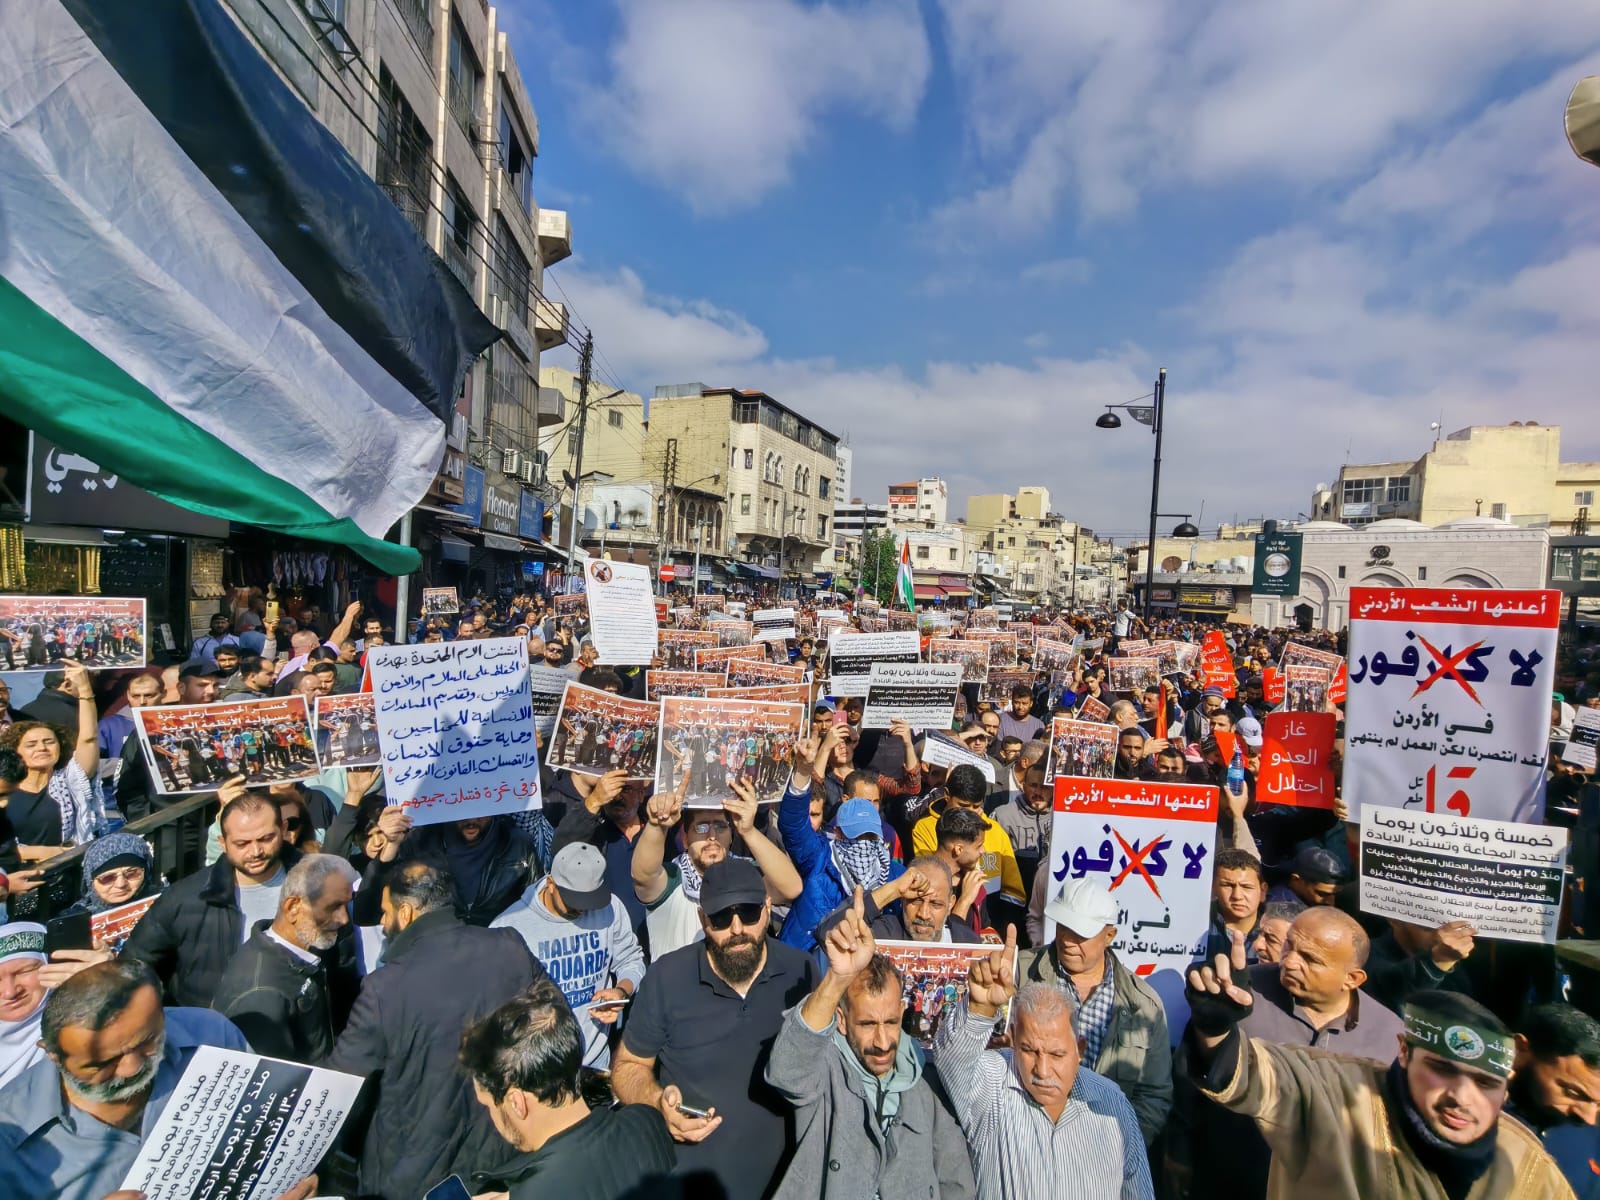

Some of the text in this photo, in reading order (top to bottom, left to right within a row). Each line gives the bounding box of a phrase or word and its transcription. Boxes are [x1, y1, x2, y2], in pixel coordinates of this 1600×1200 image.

[1359, 592, 1547, 617] أعلنها الشعب الأردني
[411, 647, 455, 664] المتحدة
[1350, 630, 1495, 690] كارفور
[469, 667, 489, 681] على
[1509, 649, 1543, 687] لا
[422, 669, 465, 692] السلام
[157, 701, 289, 722] كسر الحصار على غزة
[679, 701, 695, 712] غزة
[761, 708, 792, 716] كسر
[161, 713, 292, 732] مسؤولية الأنظمة العربية
[471, 706, 532, 725] الانسانية
[678, 715, 712, 727] العربية
[715, 715, 751, 726] الأنظمة
[1393, 703, 1494, 742] في الأردن
[495, 729, 532, 746] وحماية
[1280, 720, 1307, 740] غاز
[448, 734, 492, 754] حقوق
[1350, 735, 1384, 749] ينتهي
[1385, 735, 1399, 748] لم
[1401, 738, 1437, 753] العمل
[1439, 744, 1465, 756] لكن
[478, 753, 536, 773] والتمسك
[1271, 748, 1317, 767] العدو
[1468, 746, 1517, 763] انتصرنا
[434, 760, 479, 779] بالقانون
[484, 780, 511, 802] غزة
[512, 779, 538, 797] وفي
[1267, 772, 1323, 794] احتلال
[1064, 783, 1211, 811] أعلنها الشعب الأردني
[1421, 820, 1489, 842] وثلاثون
[1494, 828, 1553, 847] خمسة
[1053, 824, 1208, 882] لا كارفور
[1366, 847, 1396, 858] عمليات
[1409, 838, 1460, 854] وتستمر
[1463, 843, 1516, 860] المجاعة
[1396, 853, 1437, 865] الصهيوني
[1438, 860, 1469, 870] الاحتلال
[1369, 867, 1383, 876] غزة
[1384, 871, 1407, 882] قطاع
[1470, 866, 1495, 874] يواصل
[1524, 868, 1538, 877] ٣٥
[1540, 869, 1560, 881] منذ
[1409, 875, 1432, 887] شمال
[1433, 880, 1463, 892] منطقة
[1453, 874, 1489, 885] والتجويع
[1395, 889, 1438, 901] الصهيوني
[1464, 887, 1492, 896] لسكان
[1441, 898, 1472, 908] الاحتلال
[1520, 905, 1533, 913] ٣٥
[1536, 907, 1555, 917] منذ
[1132, 906, 1171, 940] في
[894, 950, 961, 960] الحصار على
[1128, 941, 1206, 956] لقد انتصرنا لكن
[912, 962, 950, 974] الأنظمة
[184, 1075, 207, 1102] منذ
[247, 1070, 271, 1100] منذ
[162, 1060, 229, 1181] مستشفيات وطواقم
[235, 1103, 252, 1124] ٣٥
[199, 1114, 214, 1133] عن
[281, 1098, 312, 1147] منذ ٣٥
[228, 1093, 277, 1183] عشرات المجازر
[253, 1117, 284, 1171] شهيد
[174, 1135, 202, 1180] الخدمة
